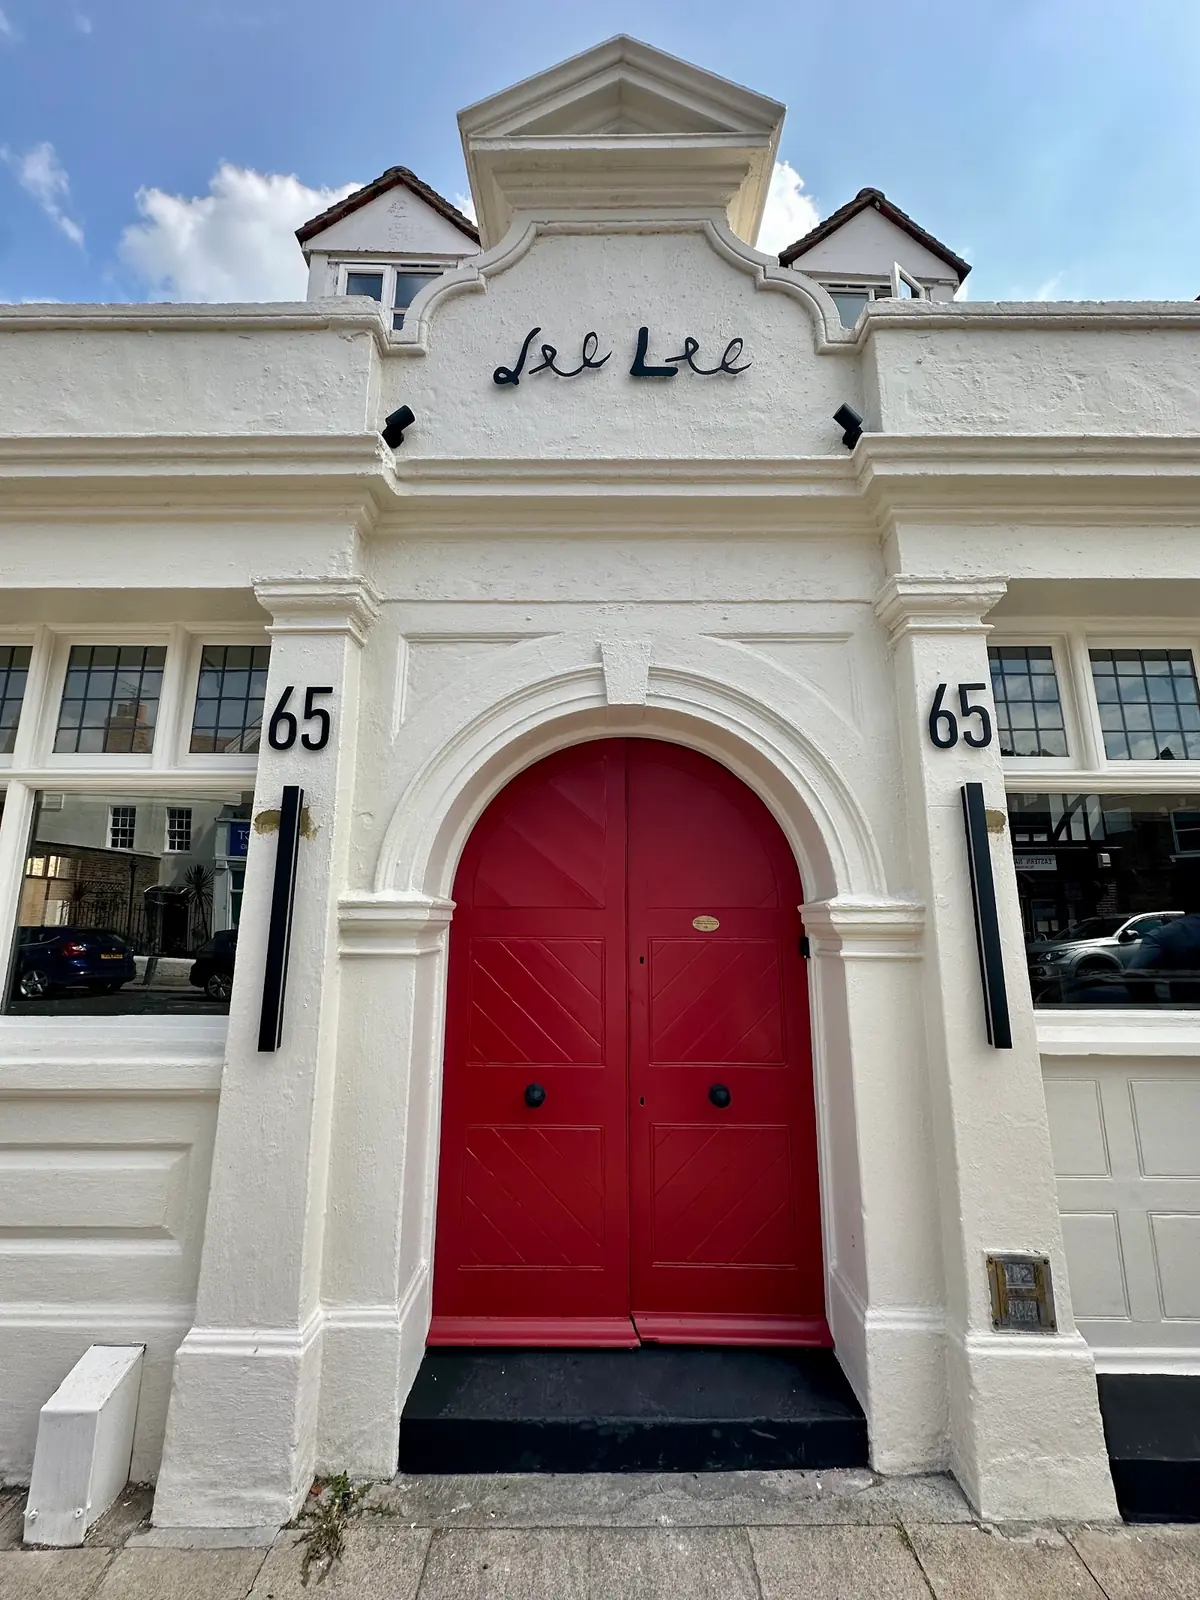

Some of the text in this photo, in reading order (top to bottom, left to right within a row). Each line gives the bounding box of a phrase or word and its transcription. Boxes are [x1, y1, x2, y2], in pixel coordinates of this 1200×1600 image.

[629, 326, 752, 382] Lee
[268, 686, 333, 751] 65
[928, 683, 992, 749] 65
